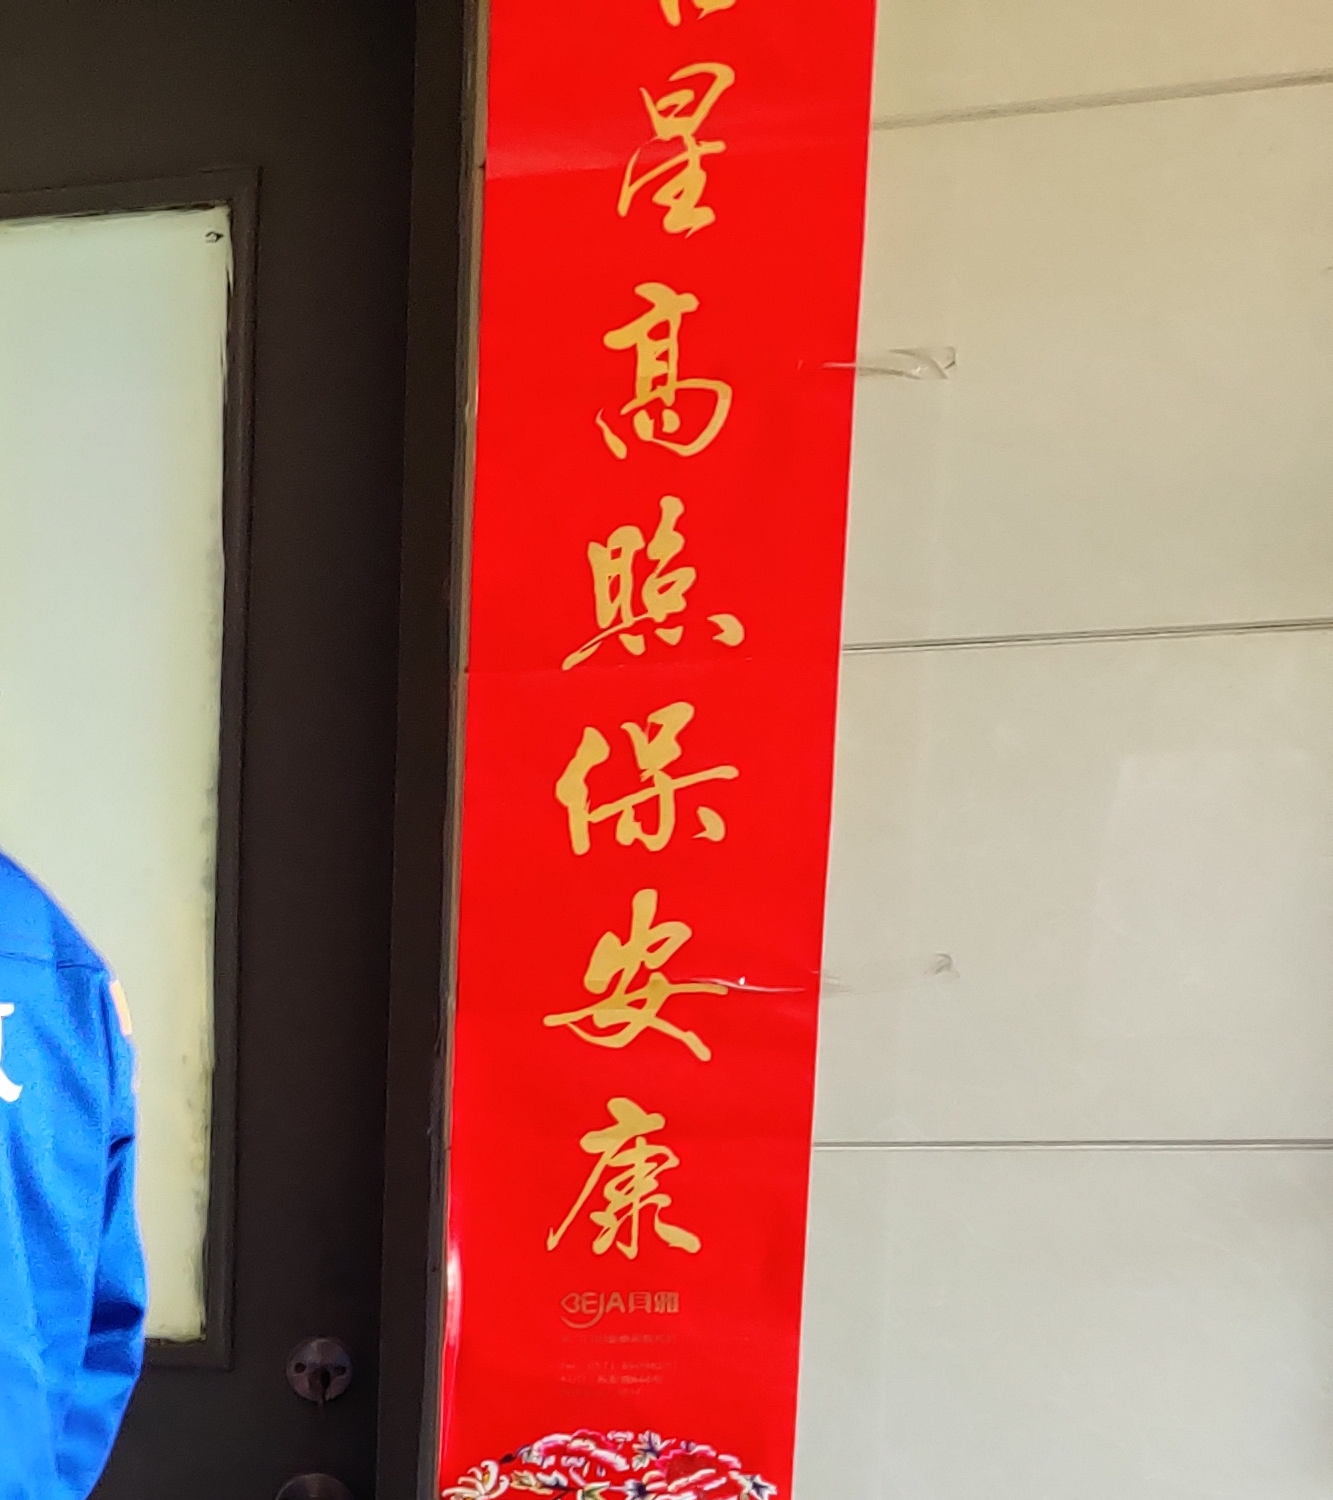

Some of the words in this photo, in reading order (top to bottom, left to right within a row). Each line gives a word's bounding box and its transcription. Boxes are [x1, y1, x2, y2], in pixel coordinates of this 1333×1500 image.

[543, 0, 745, 1260] 星高照保安康
